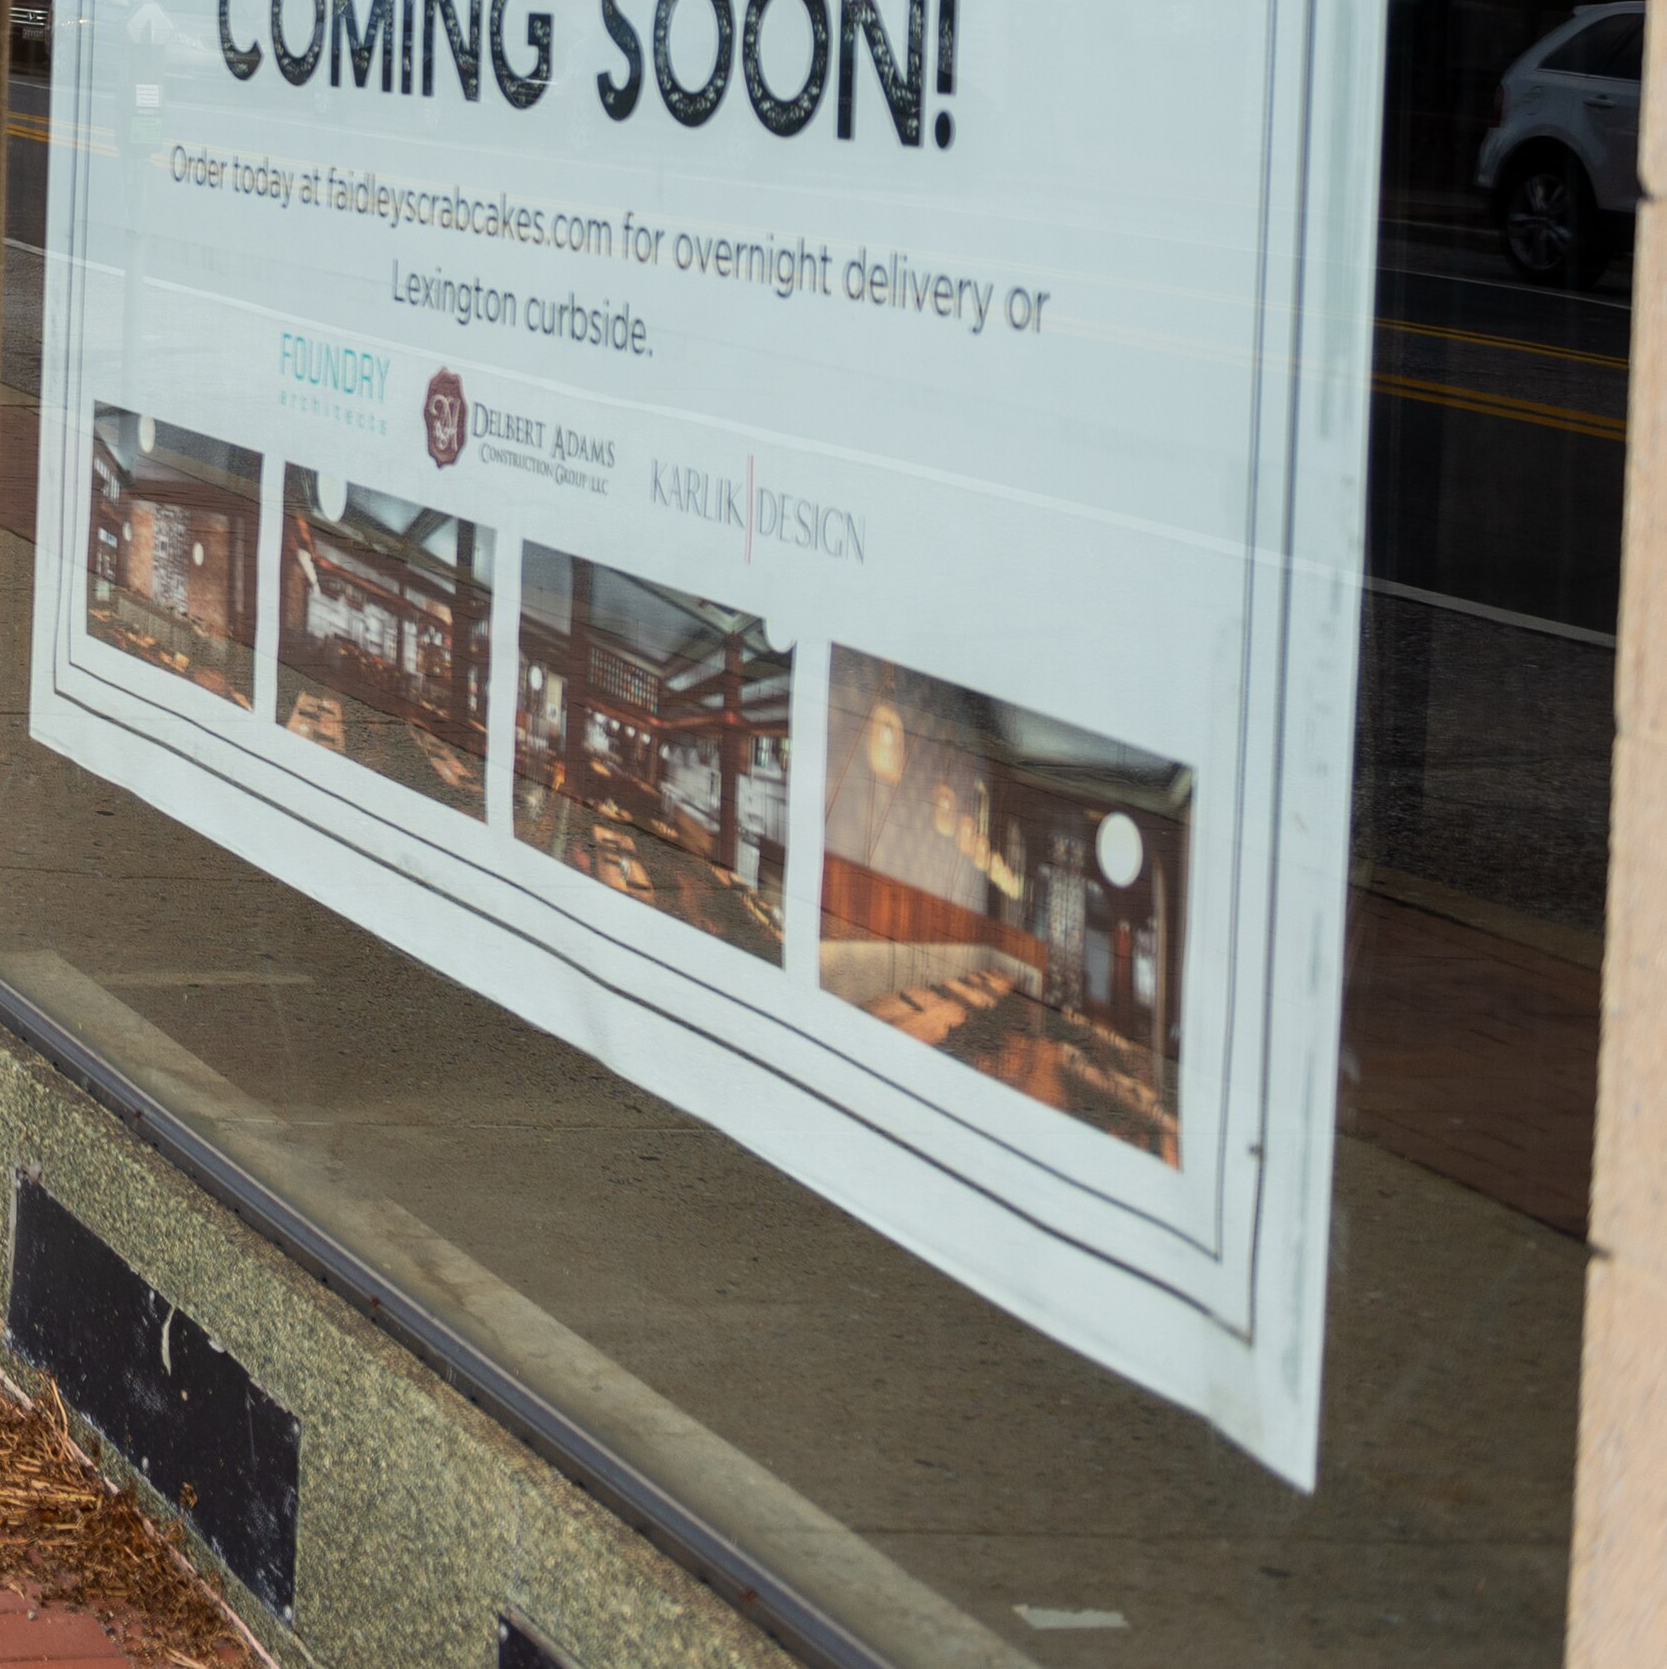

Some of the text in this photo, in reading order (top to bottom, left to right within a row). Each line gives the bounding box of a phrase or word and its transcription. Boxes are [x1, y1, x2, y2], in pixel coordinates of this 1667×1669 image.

[170, 144, 1051, 334] Order today at faidleyscrabcakes.com for overnight delivery or
[392, 259, 653, 357] Lexington curbside.
[279, 332, 391, 403] FOUNDRY
[279, 389, 388, 436] architects
[472, 401, 616, 469] DELBERT ADAMS
[651, 458, 866, 565] KARLIK DESIGN
